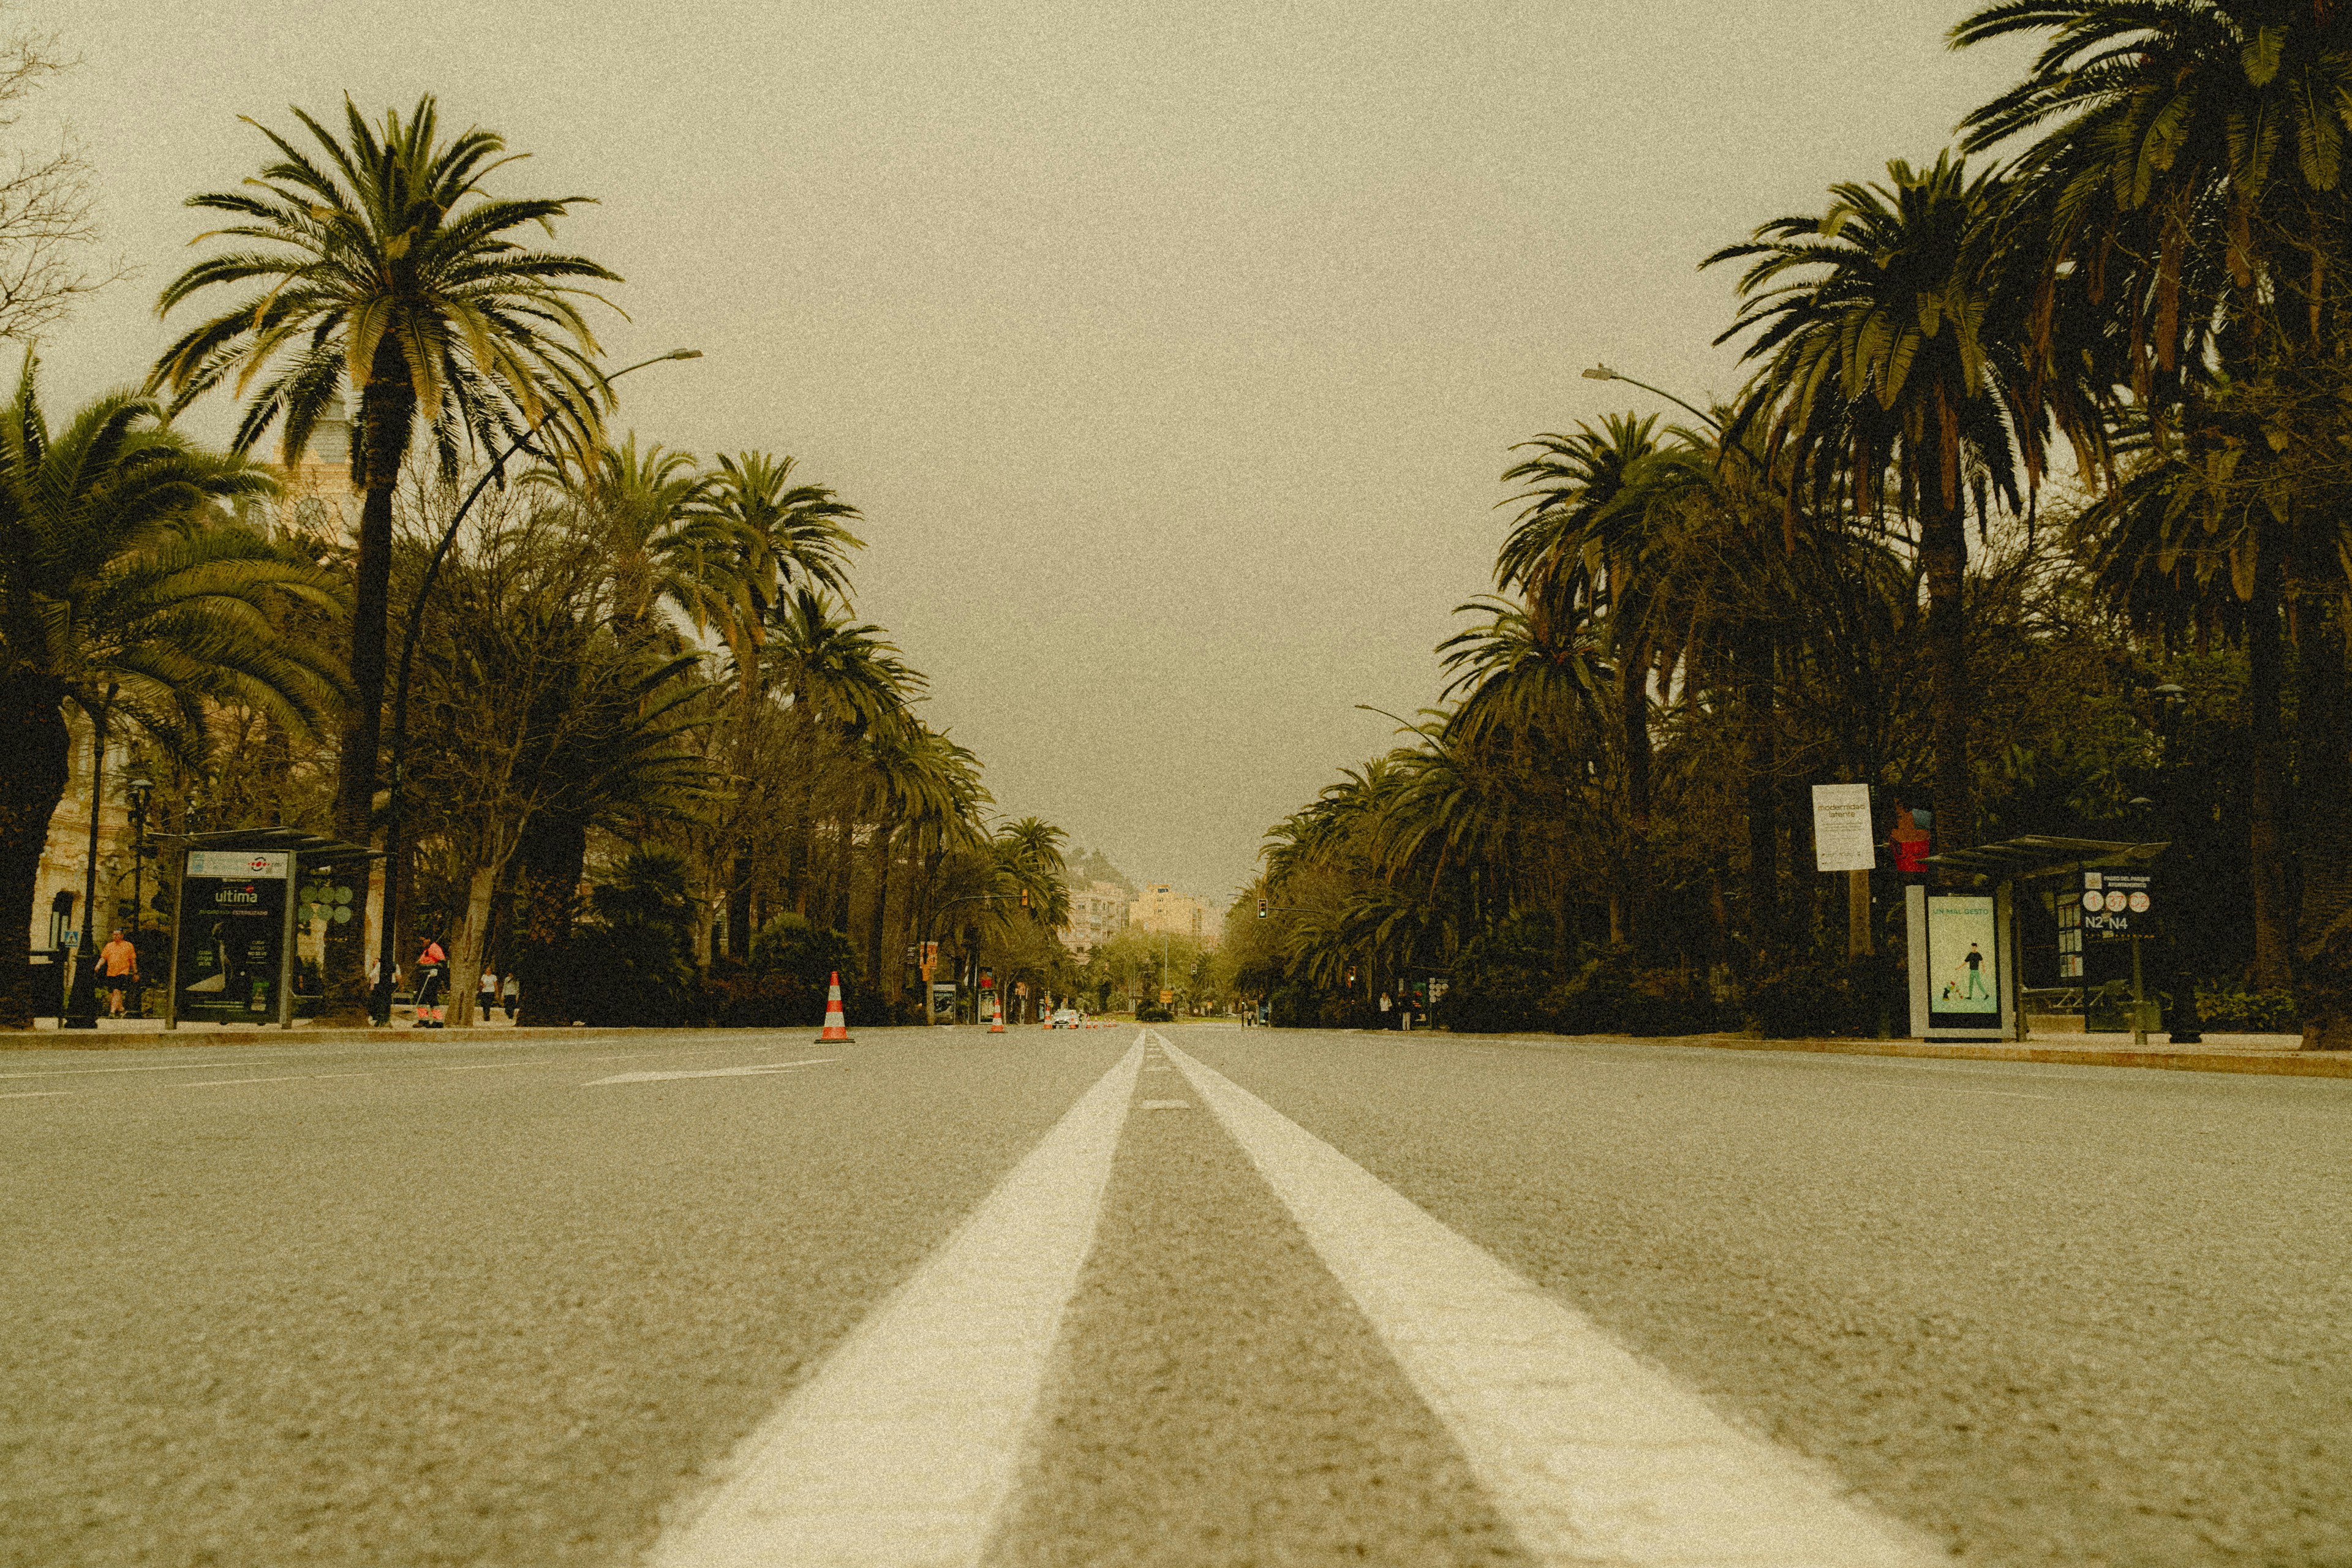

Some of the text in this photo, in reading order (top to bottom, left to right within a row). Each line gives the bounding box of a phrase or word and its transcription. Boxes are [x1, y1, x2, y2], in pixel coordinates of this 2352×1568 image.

[215, 890, 258, 903] ultima
[2090, 894, 2149, 907] 1 37 C2
[2085, 916, 2128, 929] N2 N4
